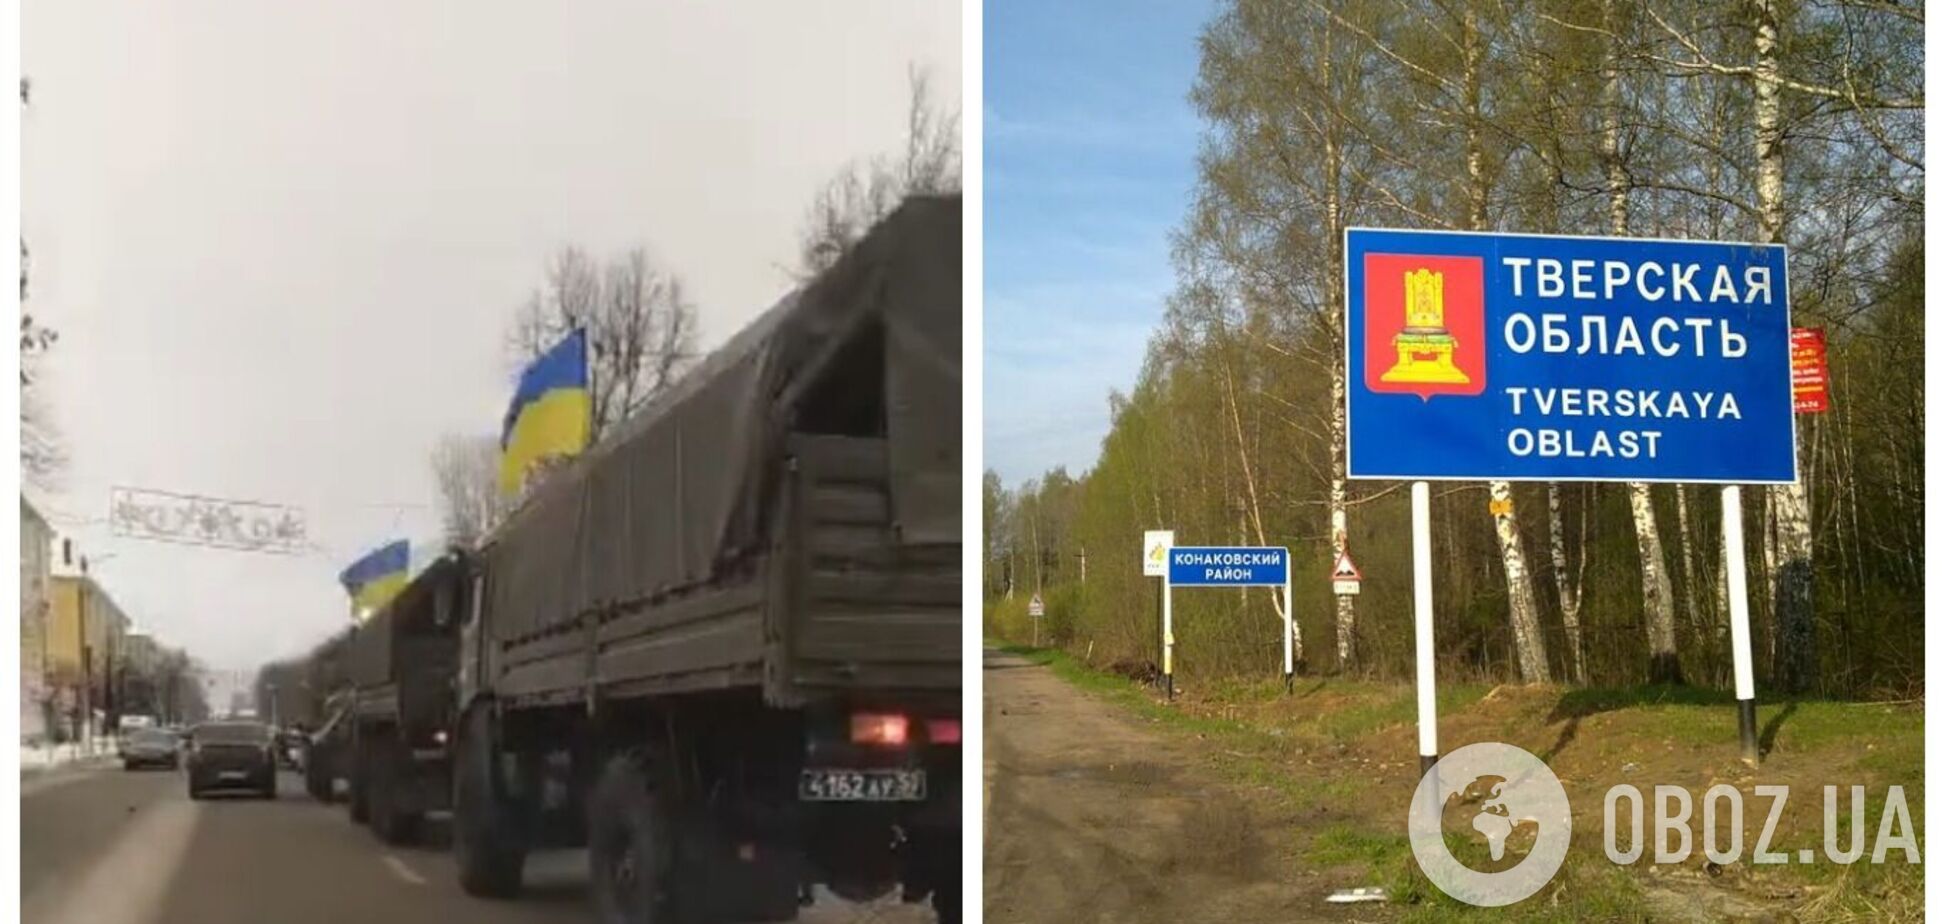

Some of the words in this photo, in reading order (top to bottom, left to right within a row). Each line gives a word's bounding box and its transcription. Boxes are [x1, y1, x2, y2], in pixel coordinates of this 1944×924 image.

[1503, 258, 1772, 305] ТВЕРСКАЯ
[1504, 313, 1747, 358] ОБЛАСТЬ
[1505, 387, 1742, 420] TVERSKAYA
[1507, 428, 1662, 458] OBLAST
[1175, 551, 1280, 566] КОНАКОВСКИЙ
[1205, 567, 1252, 580] РАЙОН
